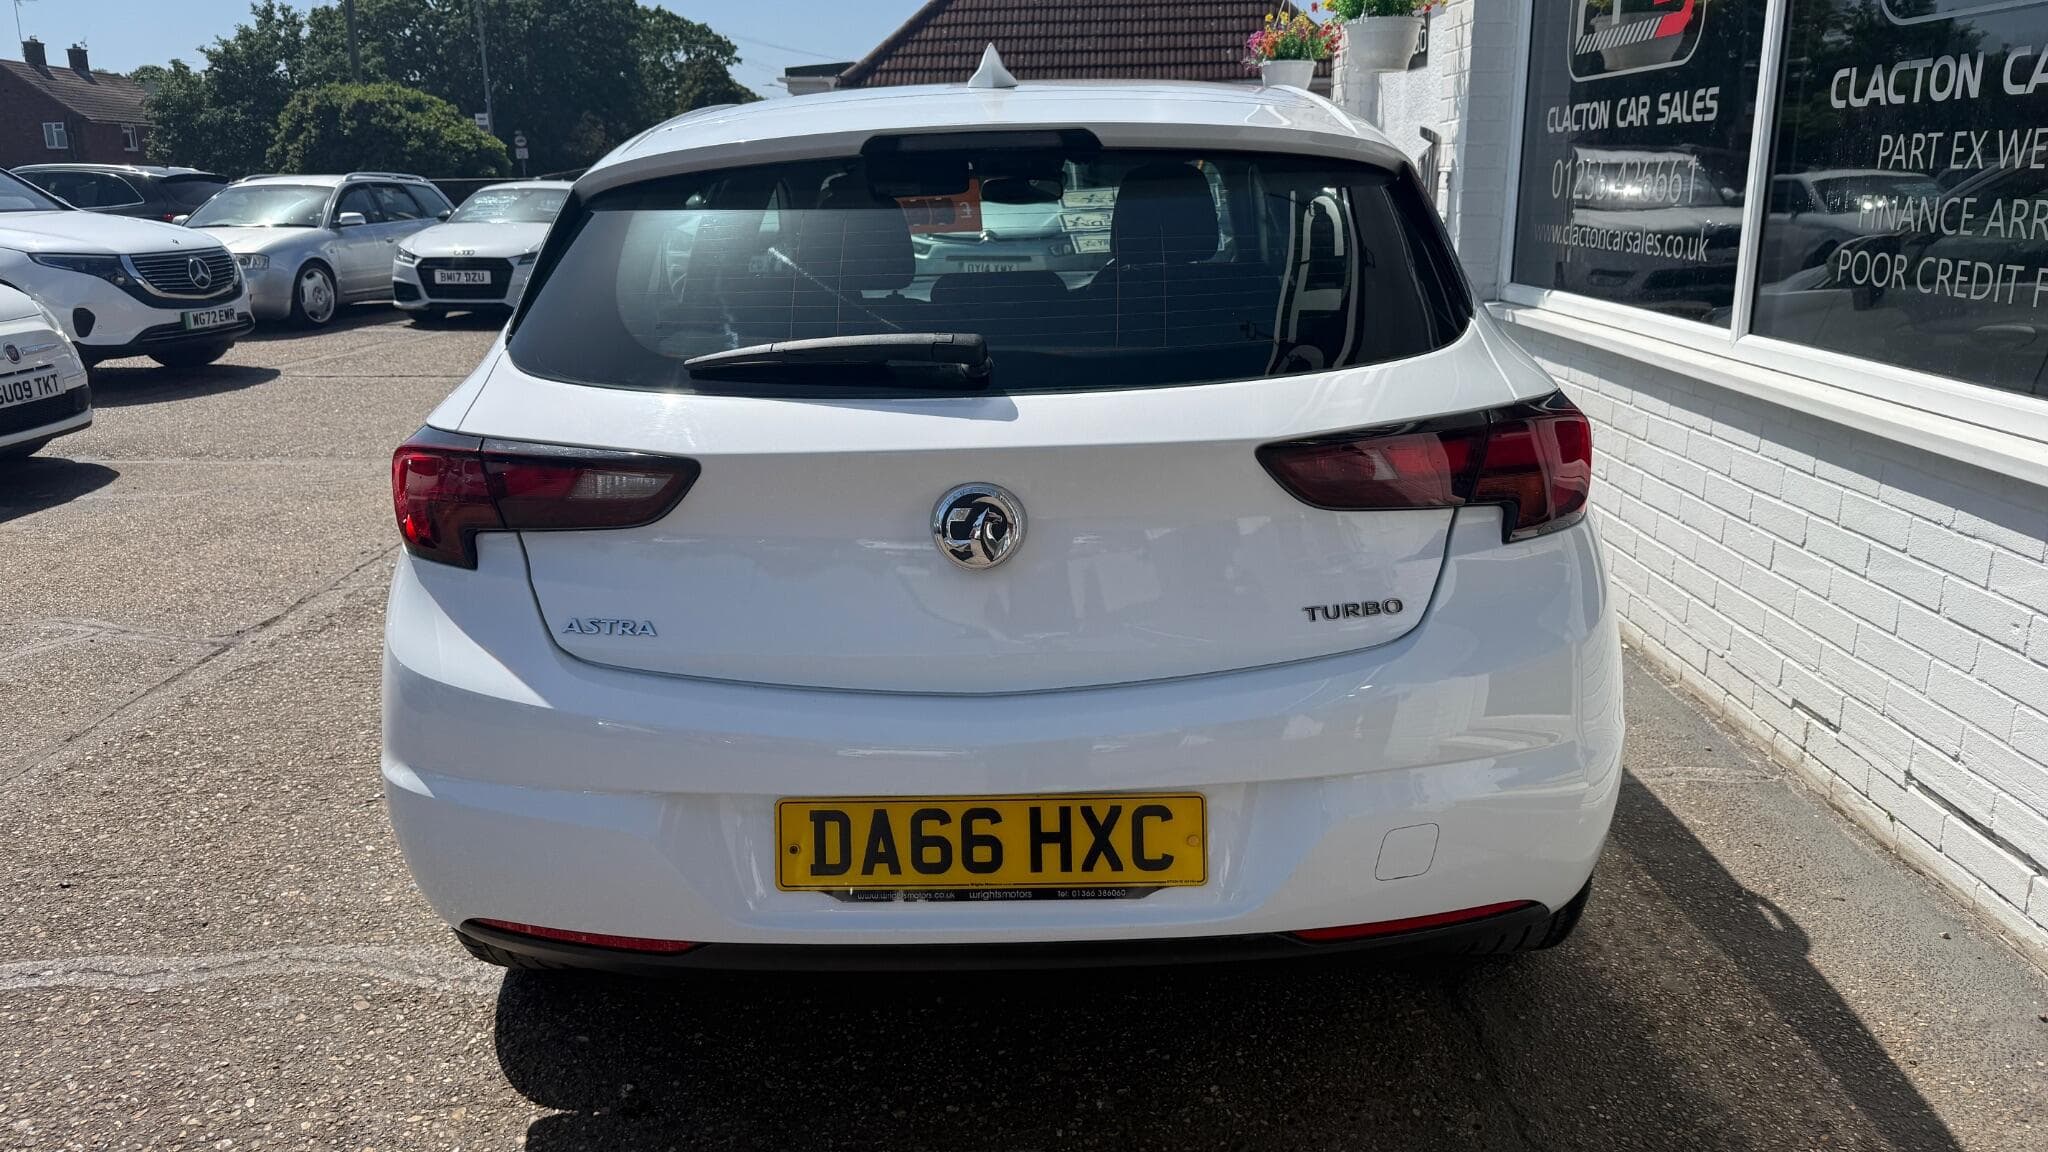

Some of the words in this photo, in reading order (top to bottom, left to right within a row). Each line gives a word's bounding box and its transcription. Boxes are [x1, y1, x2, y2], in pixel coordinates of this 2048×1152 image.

[1830, 51, 1985, 109] CLACTON
[1547, 100, 1611, 133] CLACTON
[1616, 95, 1650, 128] CAR
[1656, 86, 1720, 125] SALES
[1877, 131, 1944, 170] PART
[1950, 129, 1989, 170] EX
[1998, 127, 2048, 170] WE
[1858, 194, 1978, 236] FINANCE
[1535, 219, 1710, 262] www.clactoncarsales.co.uk
[1837, 249, 1908, 290] POOR
[1916, 256, 2025, 305] CREDIT
[192, 311, 217, 326] WG72
[218, 308, 236, 322] EWR
[34, 374, 58, 396] TKT
[562, 617, 657, 637] ASTRA
[1302, 598, 1403, 622] TURBO
[810, 806, 1003, 877] DA66
[1028, 804, 1175, 874] HXC
